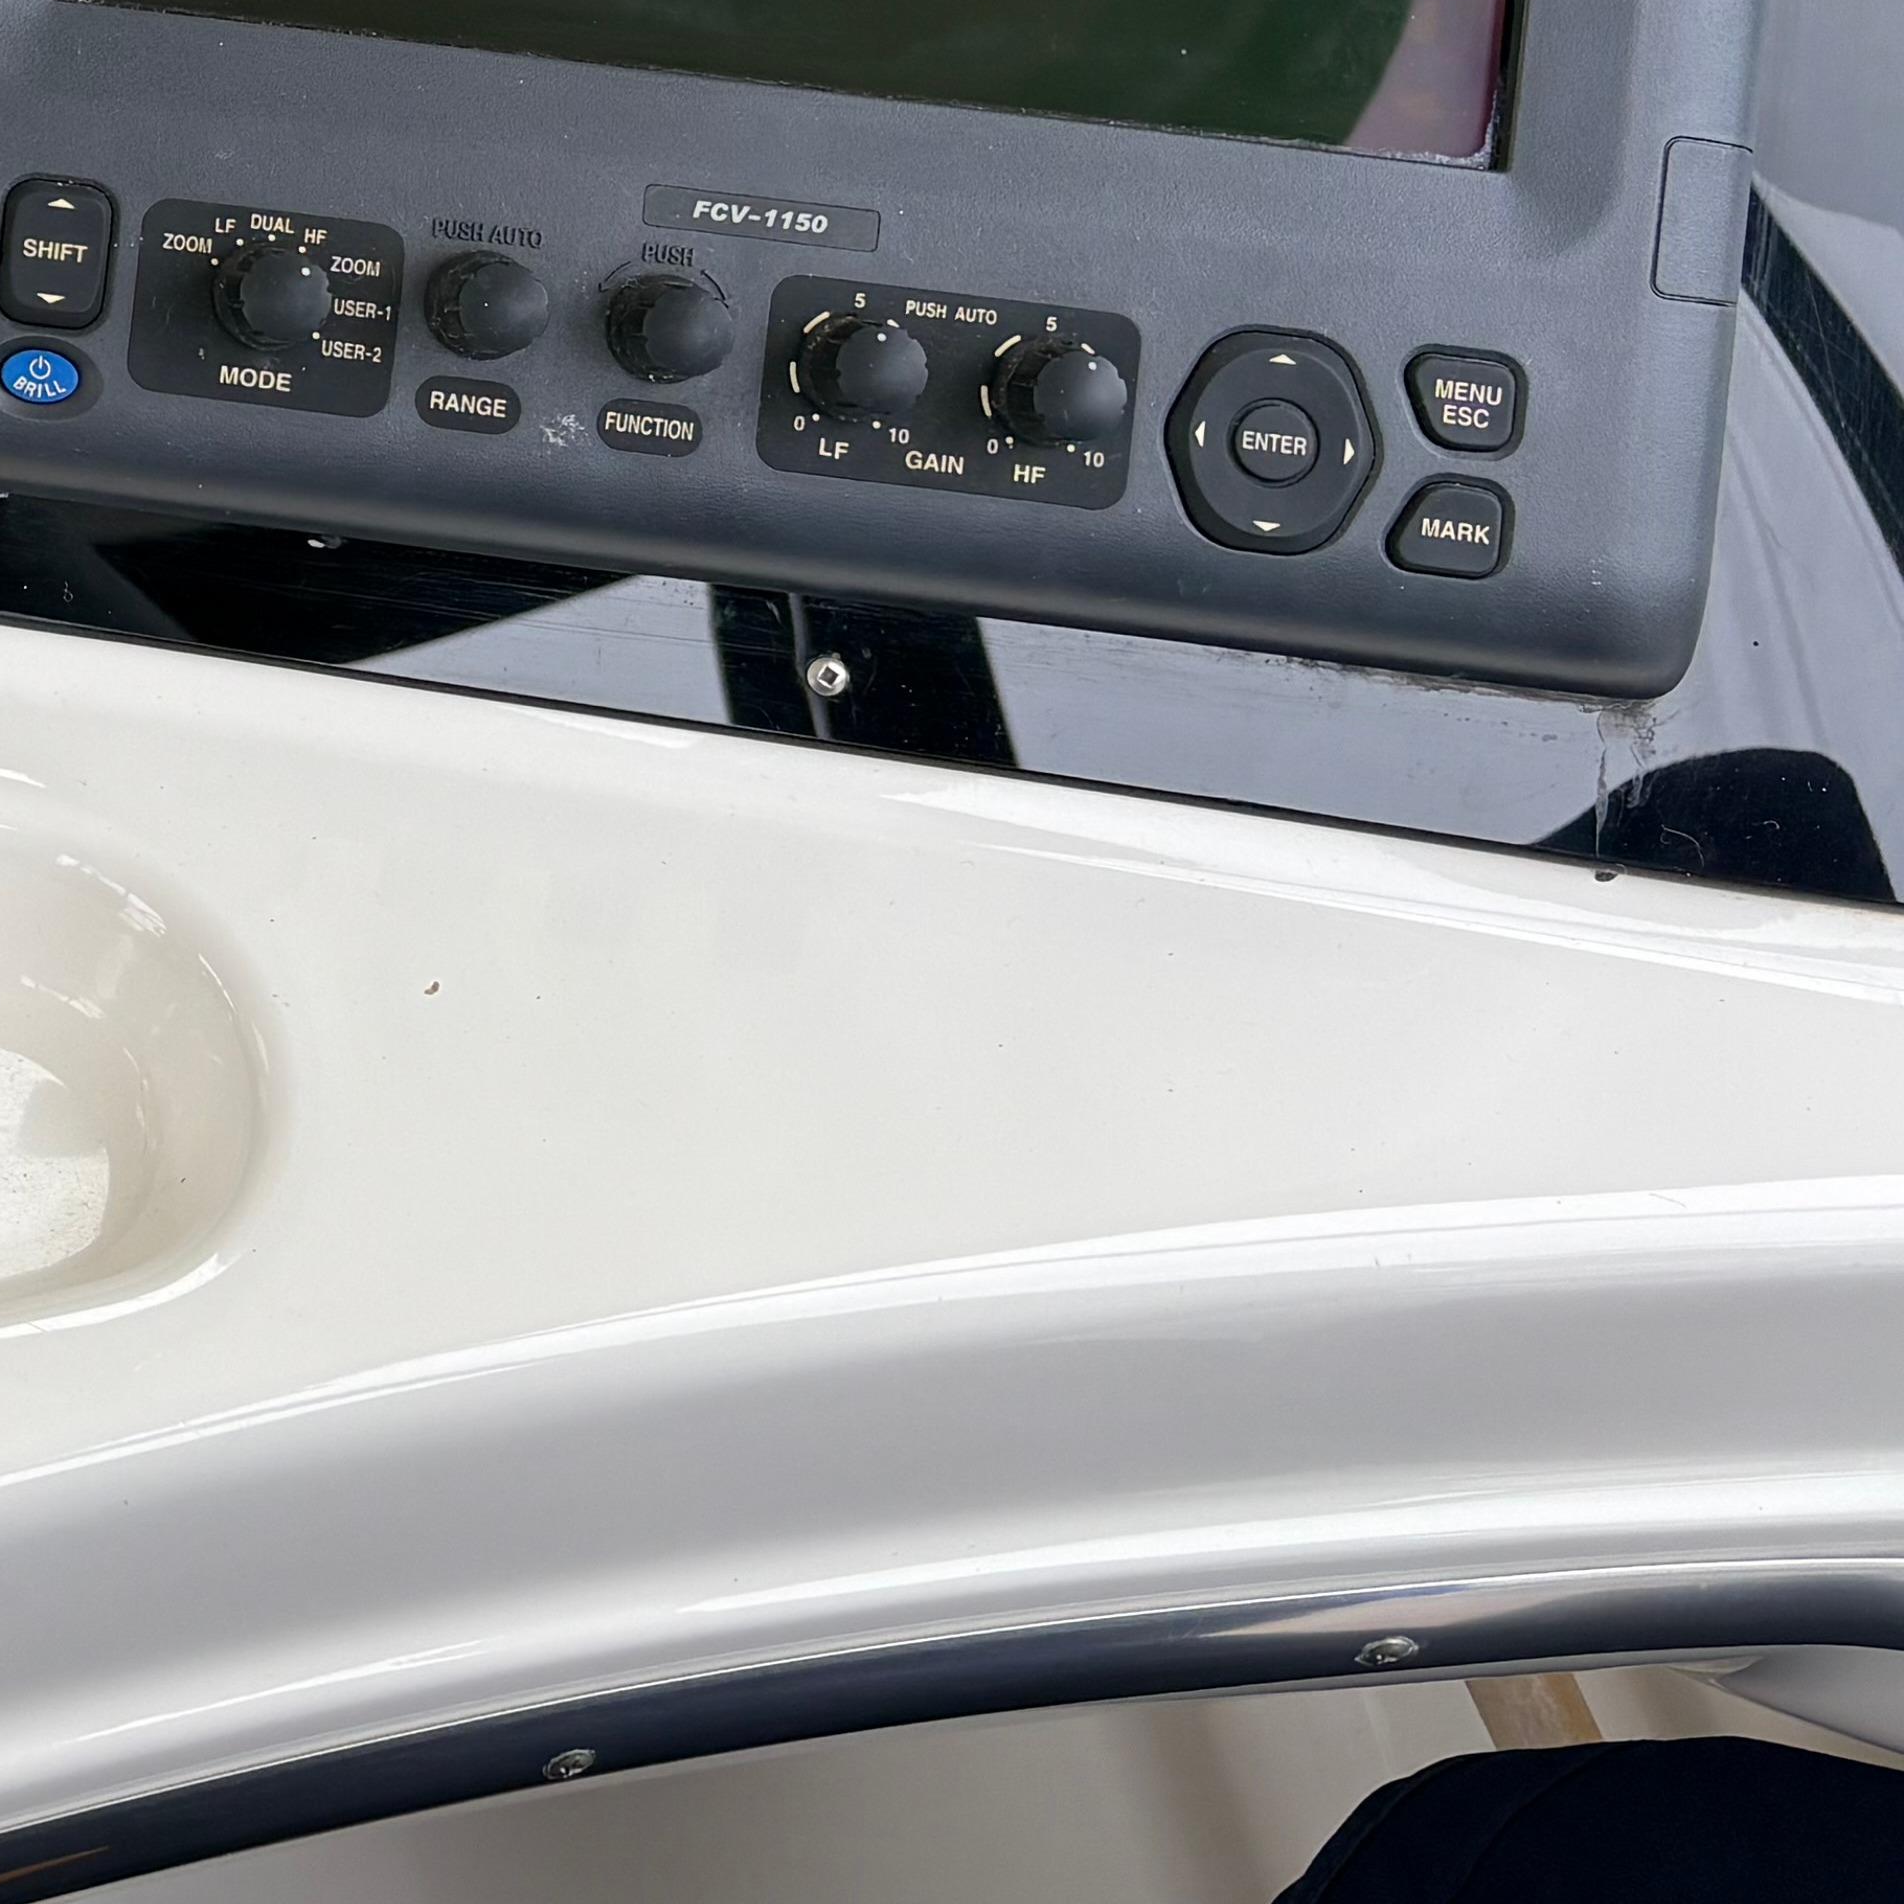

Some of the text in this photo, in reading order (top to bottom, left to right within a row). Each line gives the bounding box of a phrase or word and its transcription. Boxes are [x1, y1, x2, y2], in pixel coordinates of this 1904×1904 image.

[214, 217, 236, 234] LF
[250, 213, 295, 235] DUAL
[692, 199, 829, 234] FCV-1150
[162, 232, 213, 256] ZOOM
[303, 226, 328, 247] HF
[432, 217, 543, 249] PUSH AUTO
[22, 238, 89, 265] SHIFT
[641, 241, 696, 267] PUSH
[330, 255, 382, 278] ZOOM
[333, 298, 393, 322] USER-1
[853, 292, 868, 310] 5
[905, 299, 998, 326] PUSH AUTO
[1045, 316, 1059, 334] 5
[321, 339, 383, 364] USER-2
[12, 374, 68, 399] BRILL
[218, 364, 293, 394] MODE
[429, 389, 508, 419] RANGE
[1434, 378, 1503, 407] MENU
[604, 410, 696, 442] FUNCTION
[793, 414, 806, 433] 0
[1442, 403, 1490, 429] ESC
[818, 437, 850, 461] LF
[889, 427, 910, 446] 10
[986, 439, 999, 457] 0
[1241, 430, 1308, 457] ENTER
[905, 449, 965, 476] GAIN
[1083, 450, 1105, 469] 10
[1013, 463, 1046, 485] HF
[1420, 517, 1491, 546] MARK
